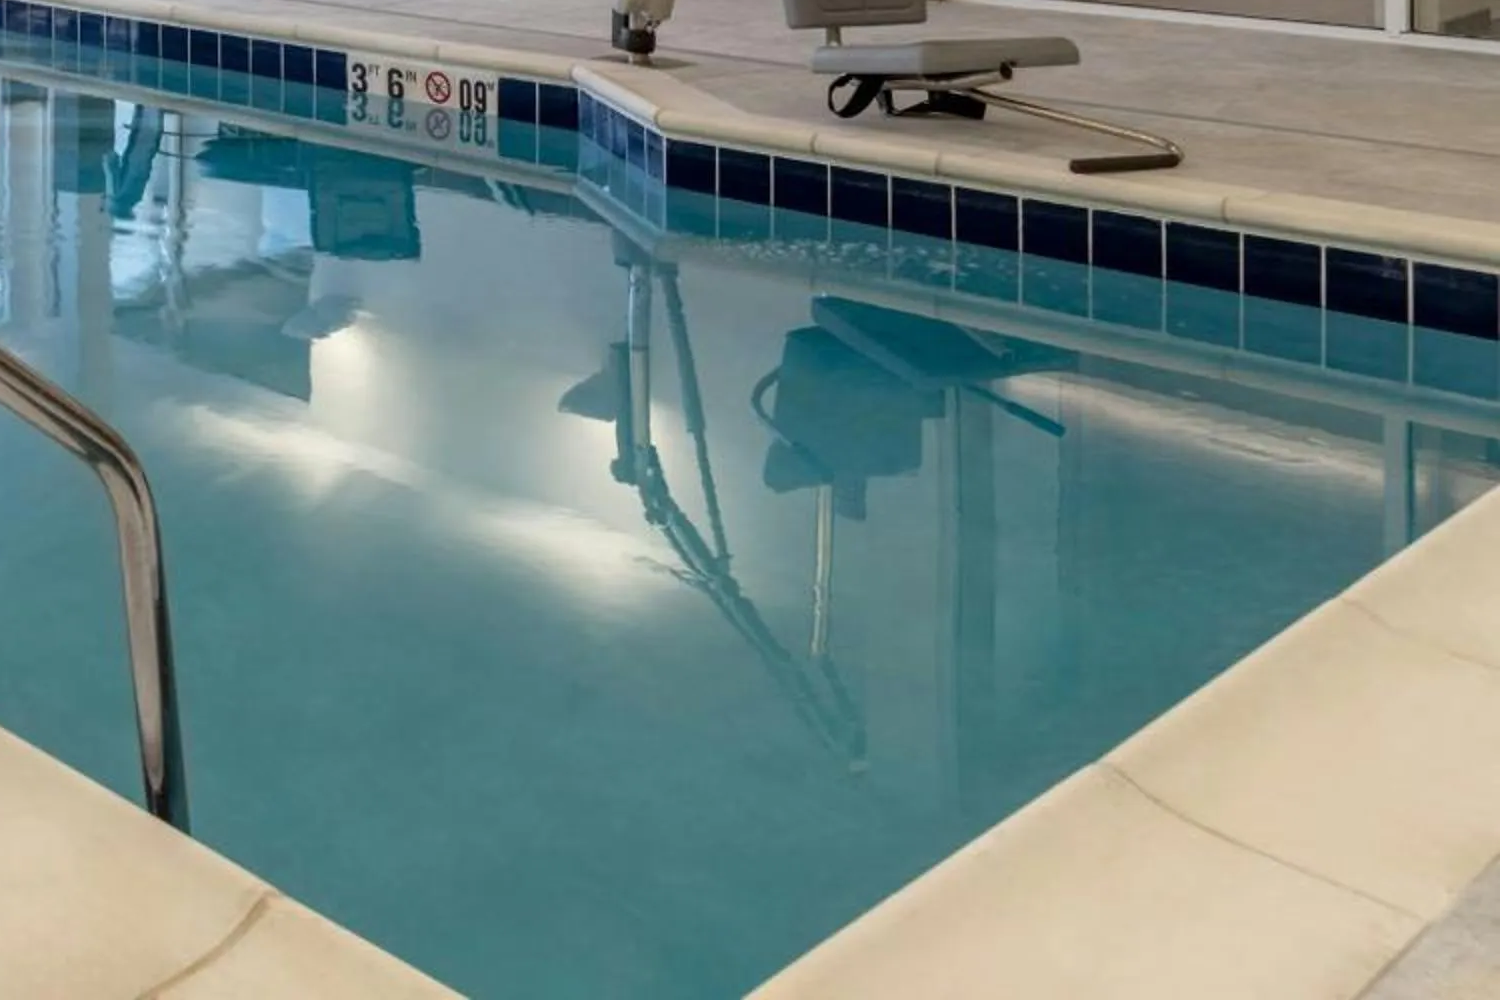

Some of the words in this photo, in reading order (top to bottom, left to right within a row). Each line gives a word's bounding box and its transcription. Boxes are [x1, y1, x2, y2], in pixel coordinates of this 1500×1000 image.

[352, 63, 368, 92] 3
[387, 67, 404, 98] 6
[459, 79, 486, 113] 09
